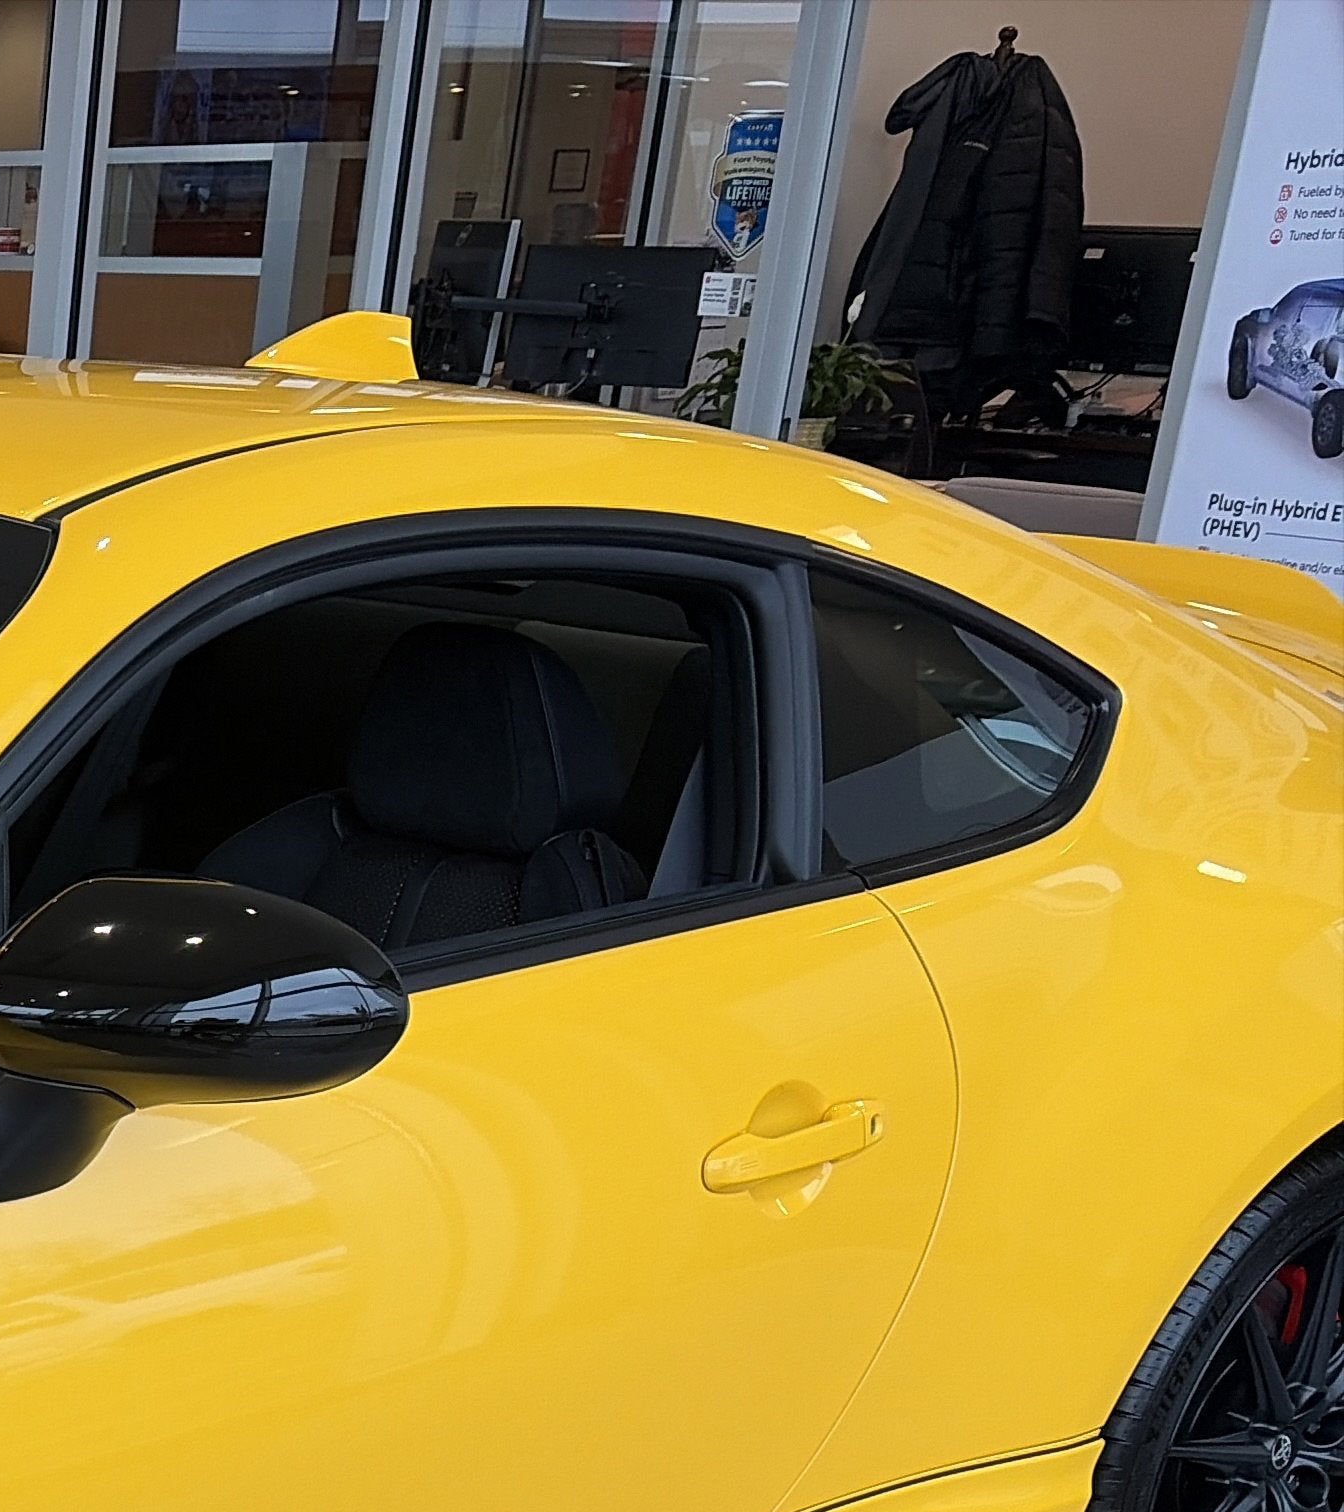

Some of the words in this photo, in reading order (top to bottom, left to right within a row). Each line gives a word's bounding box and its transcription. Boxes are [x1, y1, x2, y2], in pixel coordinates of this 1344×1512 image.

[726, 186, 772, 201] LIFETIME
[1298, 185, 1332, 198] Fueled
[1293, 208, 1308, 219] No
[1310, 207, 1337, 218] need
[1289, 229, 1320, 241] Tuned
[1321, 228, 1336, 240] for
[1208, 493, 1267, 517] Plug-in
[1270, 498, 1330, 522] Hybrid
[1203, 517, 1261, 542] (PHEV)
[1299, 560, 1332, 576] and/or
